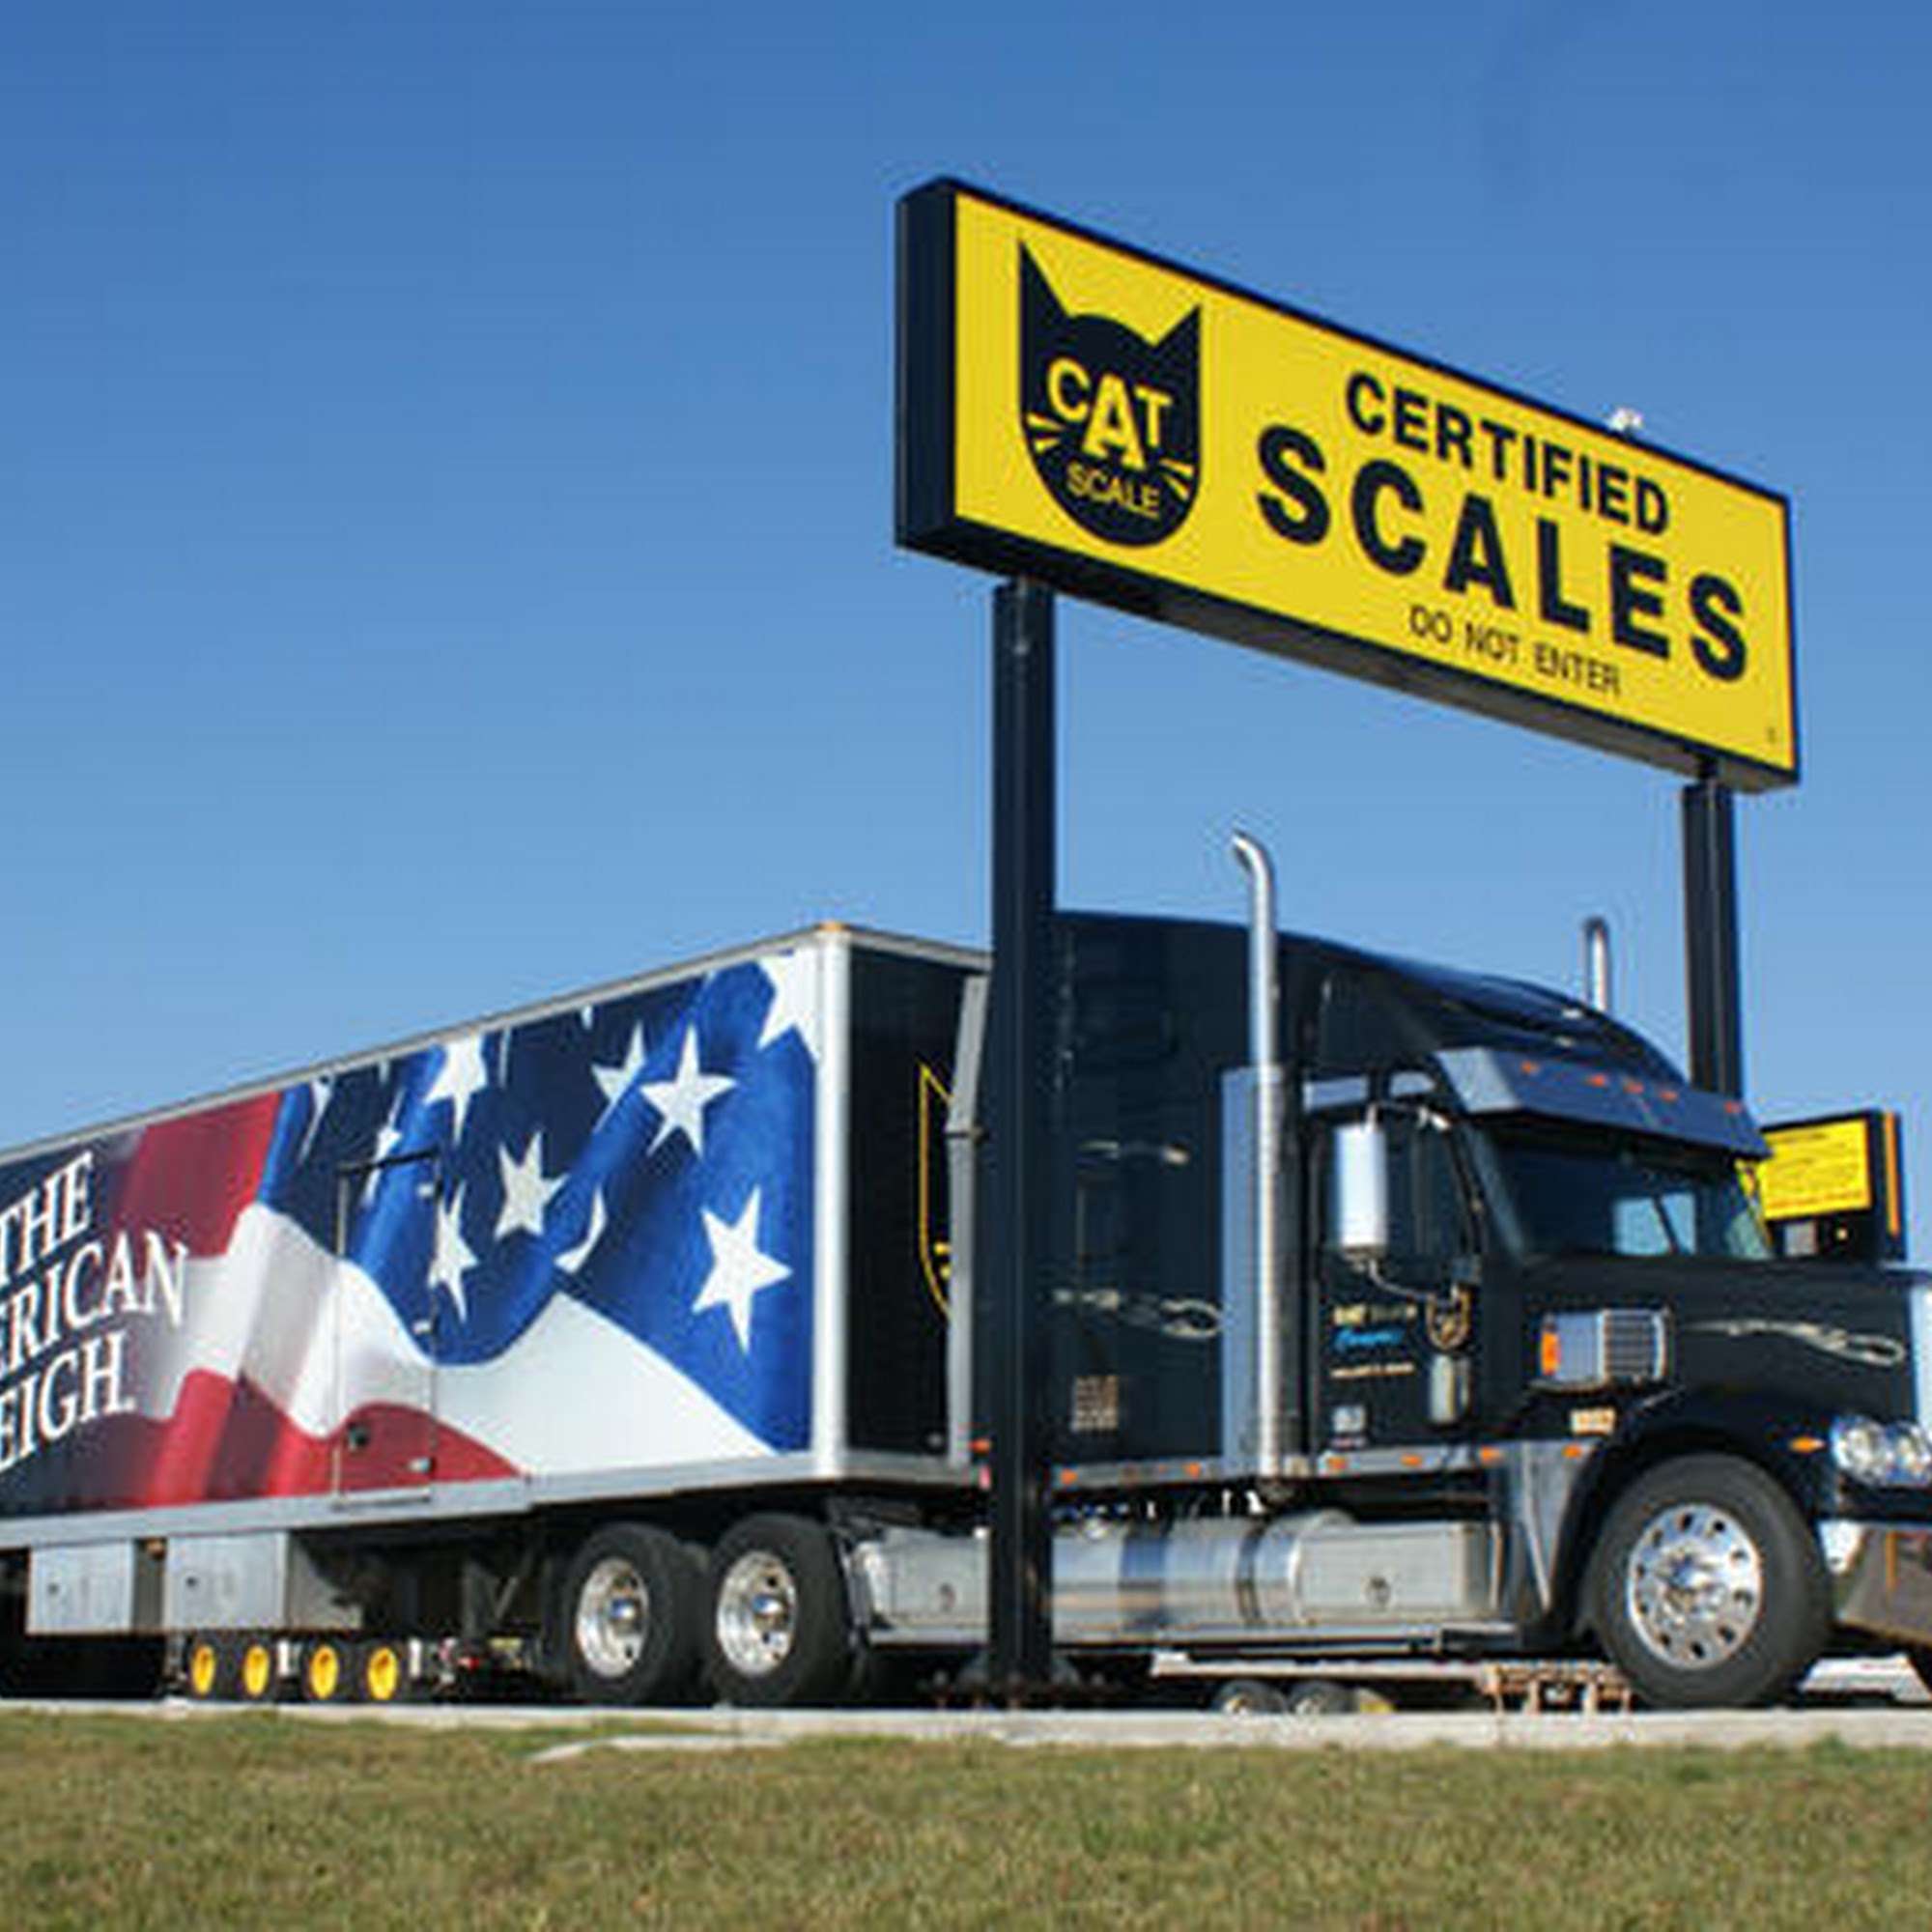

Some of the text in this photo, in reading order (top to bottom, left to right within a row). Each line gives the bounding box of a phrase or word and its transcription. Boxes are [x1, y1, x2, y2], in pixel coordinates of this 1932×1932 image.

[1048, 358, 1172, 470] CAT
[1346, 372, 1668, 535] CERTIFIED
[1066, 460, 1160, 519] SCALE
[1258, 425, 1747, 682] SCALES
[1409, 605, 1621, 696] DO NOT ENTER
[0, 1230, 188, 1379] RICAN
